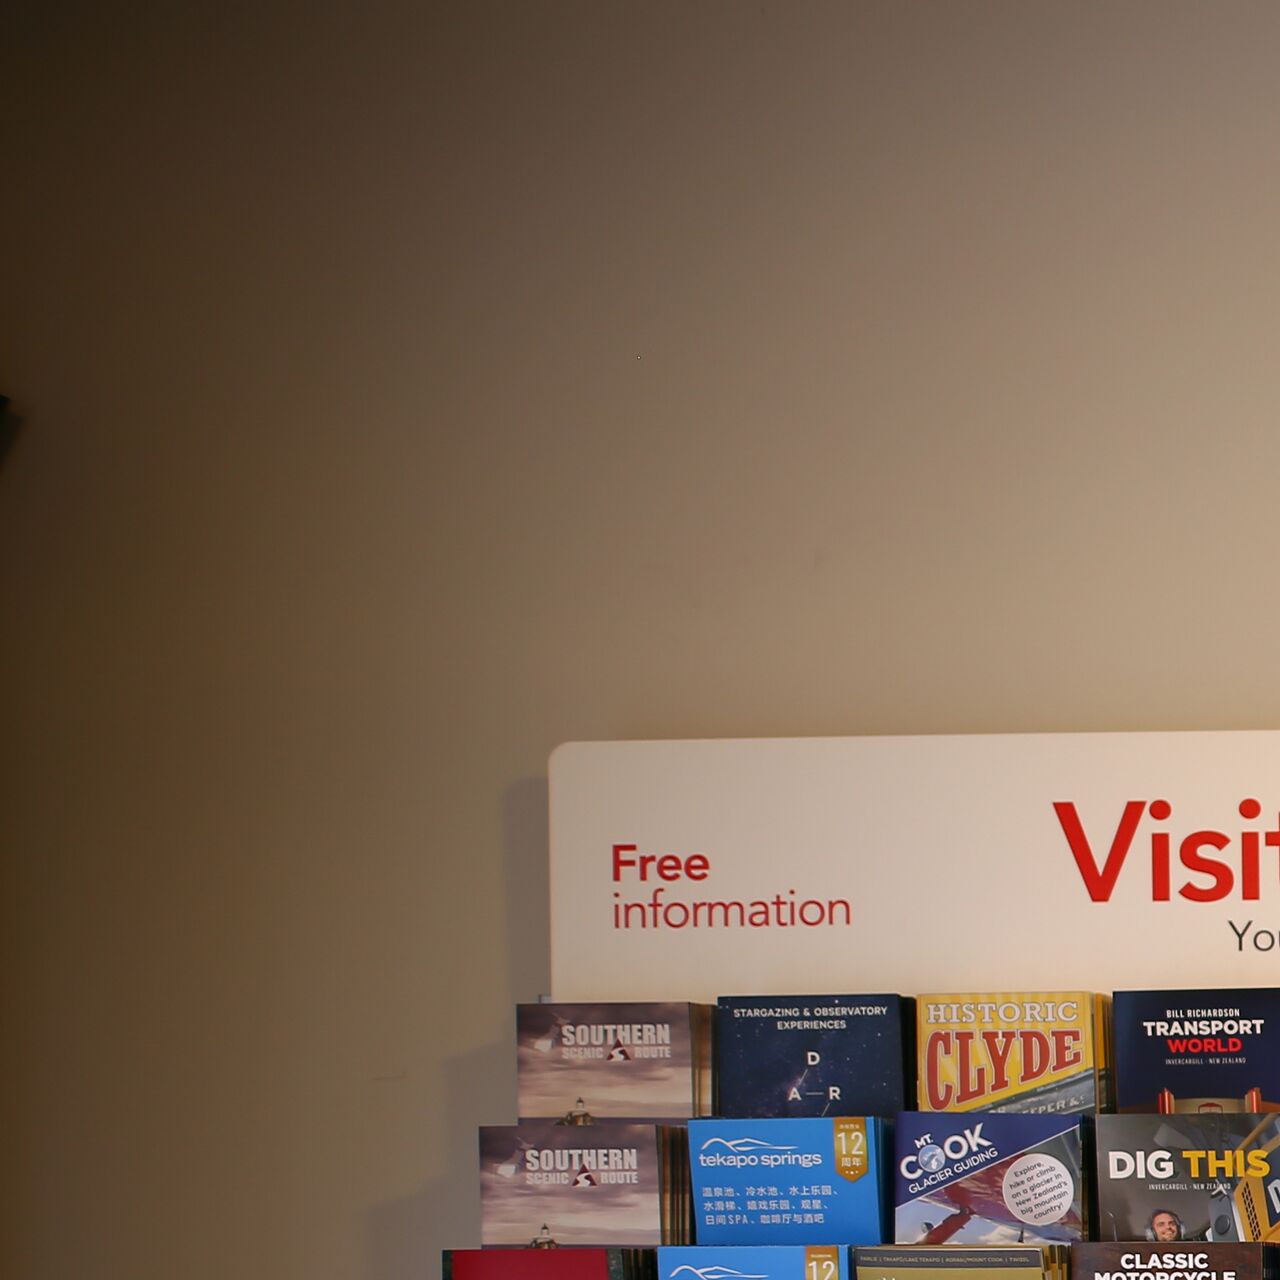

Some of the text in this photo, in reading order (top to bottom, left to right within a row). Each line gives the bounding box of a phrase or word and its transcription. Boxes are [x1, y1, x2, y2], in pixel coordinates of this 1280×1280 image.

[611, 844, 710, 882] Free
[613, 890, 851, 930] information
[733, 1006, 888, 1018] STARGAZING & OBSERVATORY
[927, 1001, 1079, 1024] HISTORIC
[1166, 1009, 1240, 1017] BILL RICHARDSON
[776, 1020, 847, 1030] EXPERIENCES
[1143, 1020, 1264, 1037] TRANSPORT
[561, 1024, 671, 1046] SOUTHERN
[562, 1046, 671, 1059] SCENIC ROUTE
[1167, 1038, 1242, 1053] WORLD
[925, 1029, 1082, 1111] CLYDE
[1108, 1149, 1271, 1179] DIG THIS
[1120, 1254, 1209, 1270] CLASSIC
